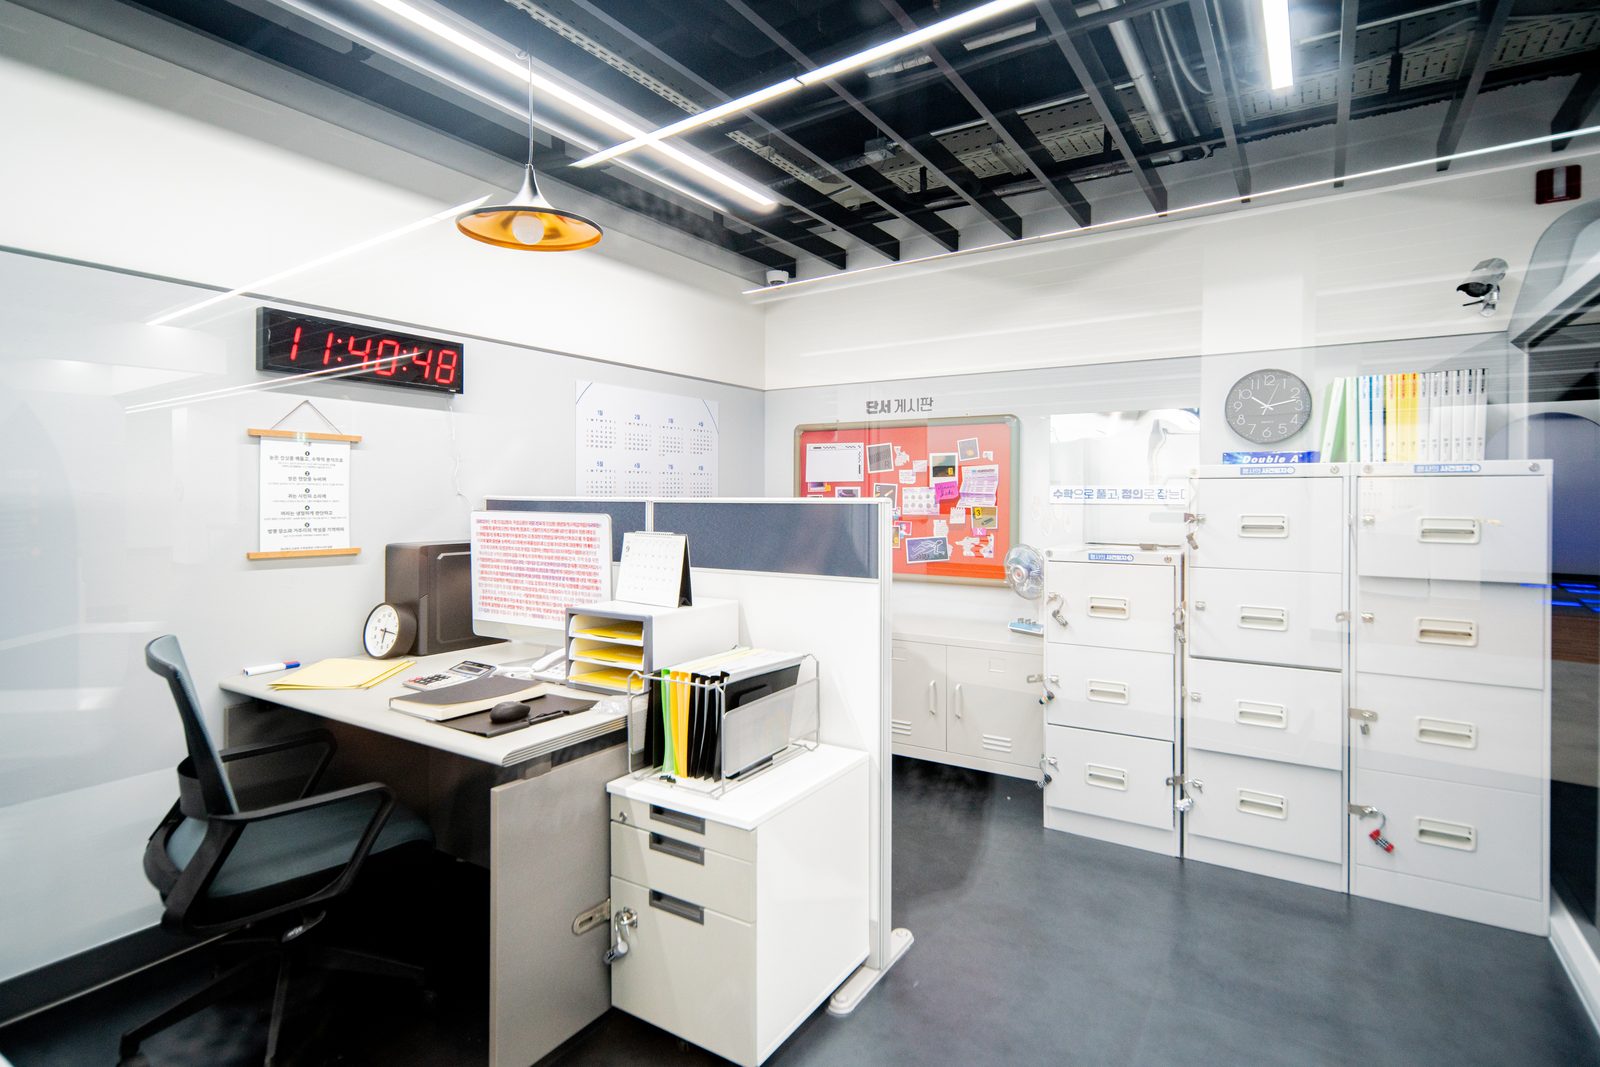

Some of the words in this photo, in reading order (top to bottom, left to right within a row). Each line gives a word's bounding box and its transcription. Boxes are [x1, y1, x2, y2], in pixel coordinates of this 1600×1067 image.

[1251, 379, 1260, 390] 11
[1264, 375, 1275, 386] 12
[1238, 389, 1252, 400] 10
[1290, 387, 1300, 399] 2
[866, 400, 891, 414] 단서
[894, 397, 934, 413] 게시판
[1233, 401, 1243, 412] 9
[1295, 399, 1304, 411] 3
[1236, 414, 1246, 425] 8
[1290, 414, 1298, 425] 4
[1248, 423, 1257, 435] 7
[1262, 427, 1272, 438] 6
[1278, 423, 1288, 435] 5
[1242, 455, 1286, 464] Double
[1287, 455, 1299, 463] A
[1053, 488, 1094, 499] 수학으로
[1122, 488, 1155, 500] 정의로
